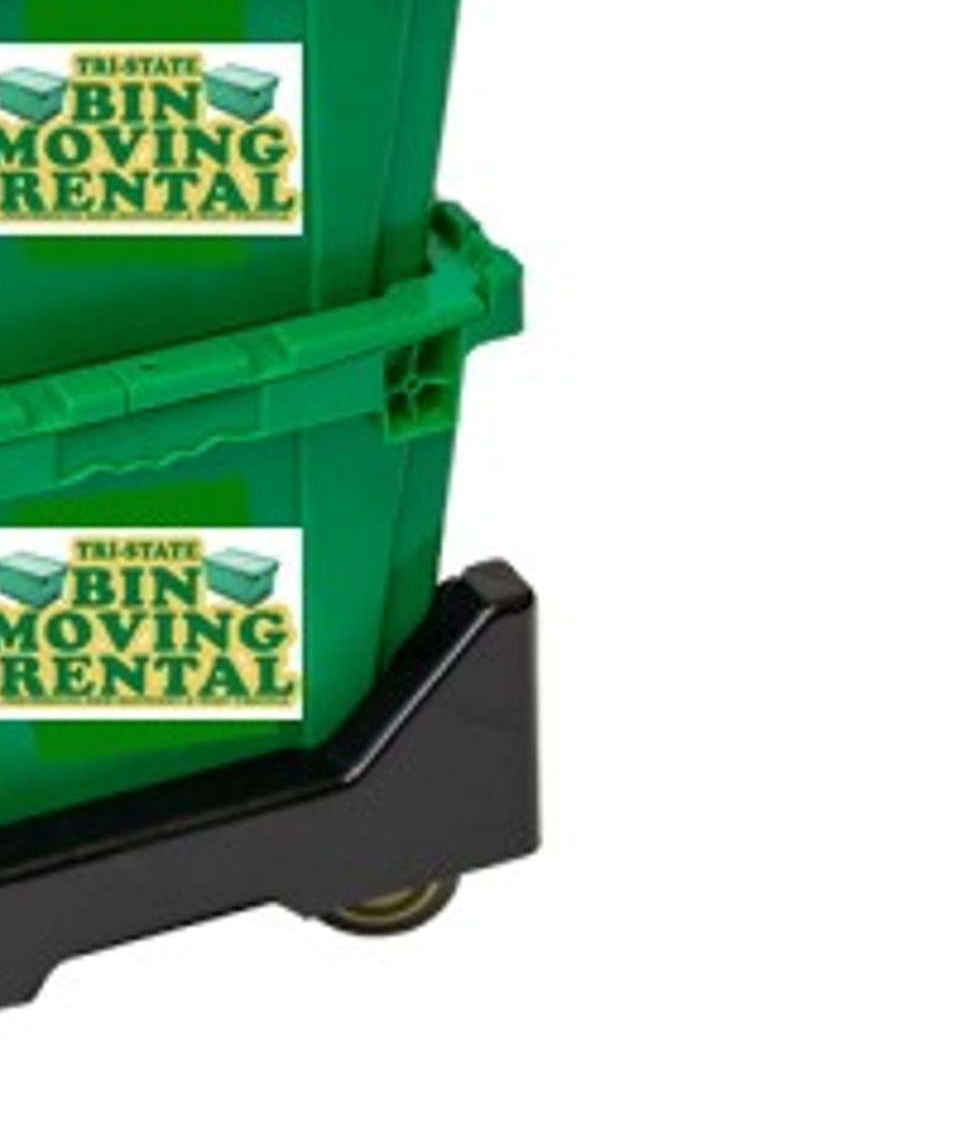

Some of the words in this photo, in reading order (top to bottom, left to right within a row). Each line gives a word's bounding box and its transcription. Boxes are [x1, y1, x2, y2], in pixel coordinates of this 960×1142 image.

[75, 55, 200, 76] TRI-STATE
[72, 81, 202, 122] BIN
[75, 540, 200, 561] TRI-STATE
[72, 566, 202, 607] BIN
